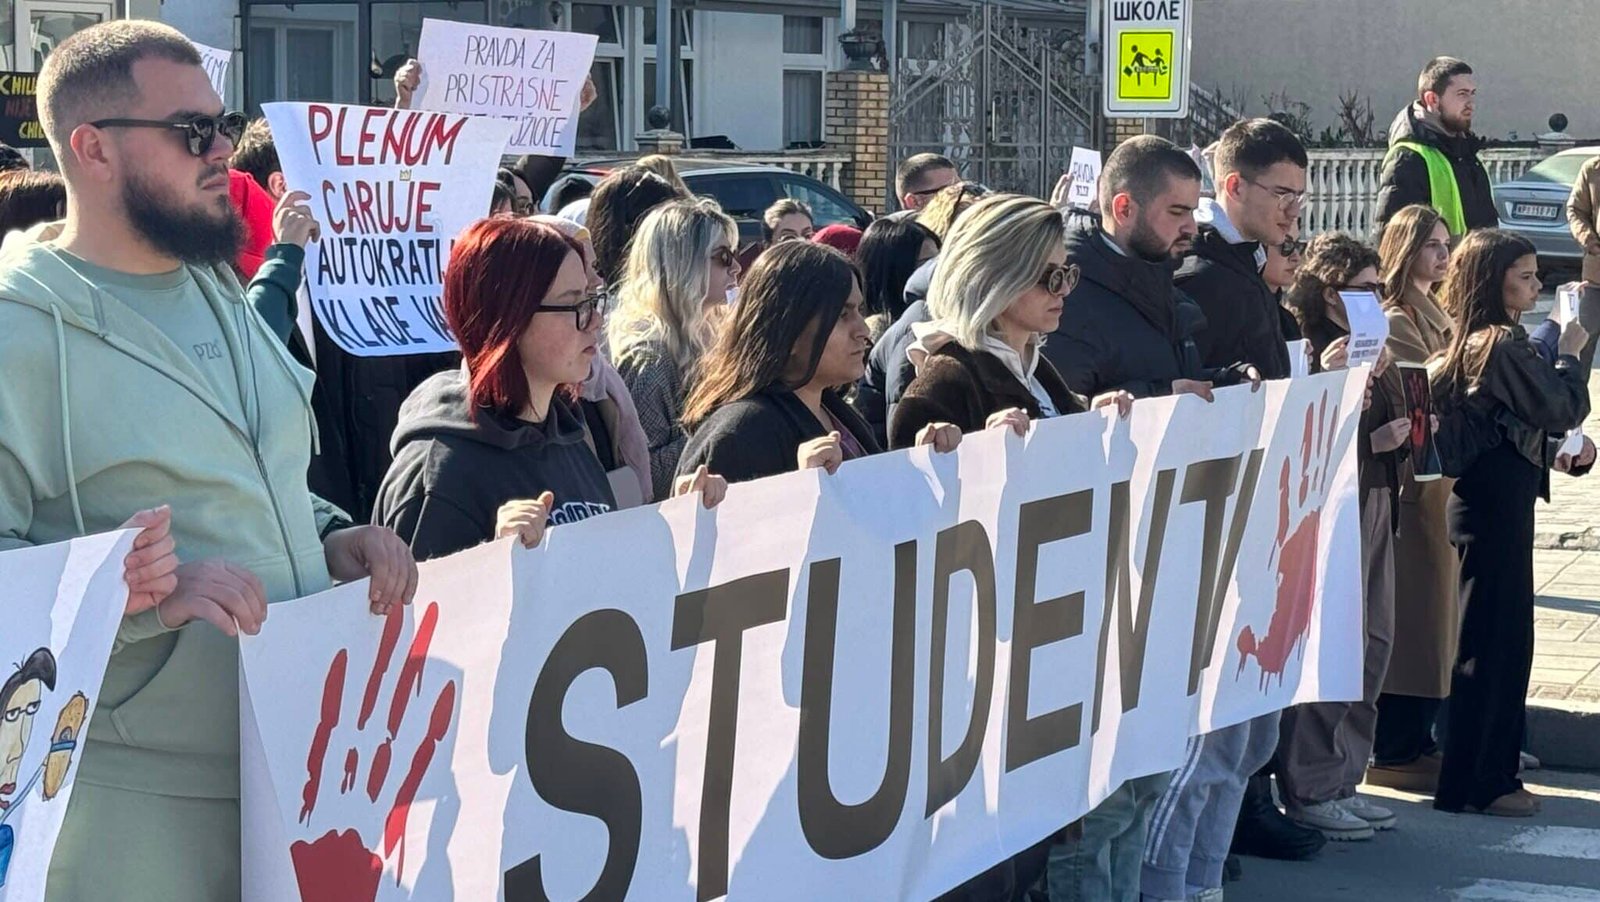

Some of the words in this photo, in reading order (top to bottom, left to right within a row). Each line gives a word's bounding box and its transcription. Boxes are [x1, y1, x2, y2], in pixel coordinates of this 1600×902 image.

[1114, 0, 1180, 21] ШКОЛЕ
[464, 34, 527, 69] PRAVDA
[531, 38, 556, 73] ZA
[444, 73, 569, 112] PRISTRASNE
[18, 121, 45, 139] CHIL
[308, 104, 470, 166] PLENUM
[501, 112, 568, 148] UŽIOCE
[321, 179, 442, 234] CARUJE
[317, 237, 455, 288] AUTOKRATI
[318, 295, 428, 349] KLADE
[503, 447, 1264, 902] STUDENTI
